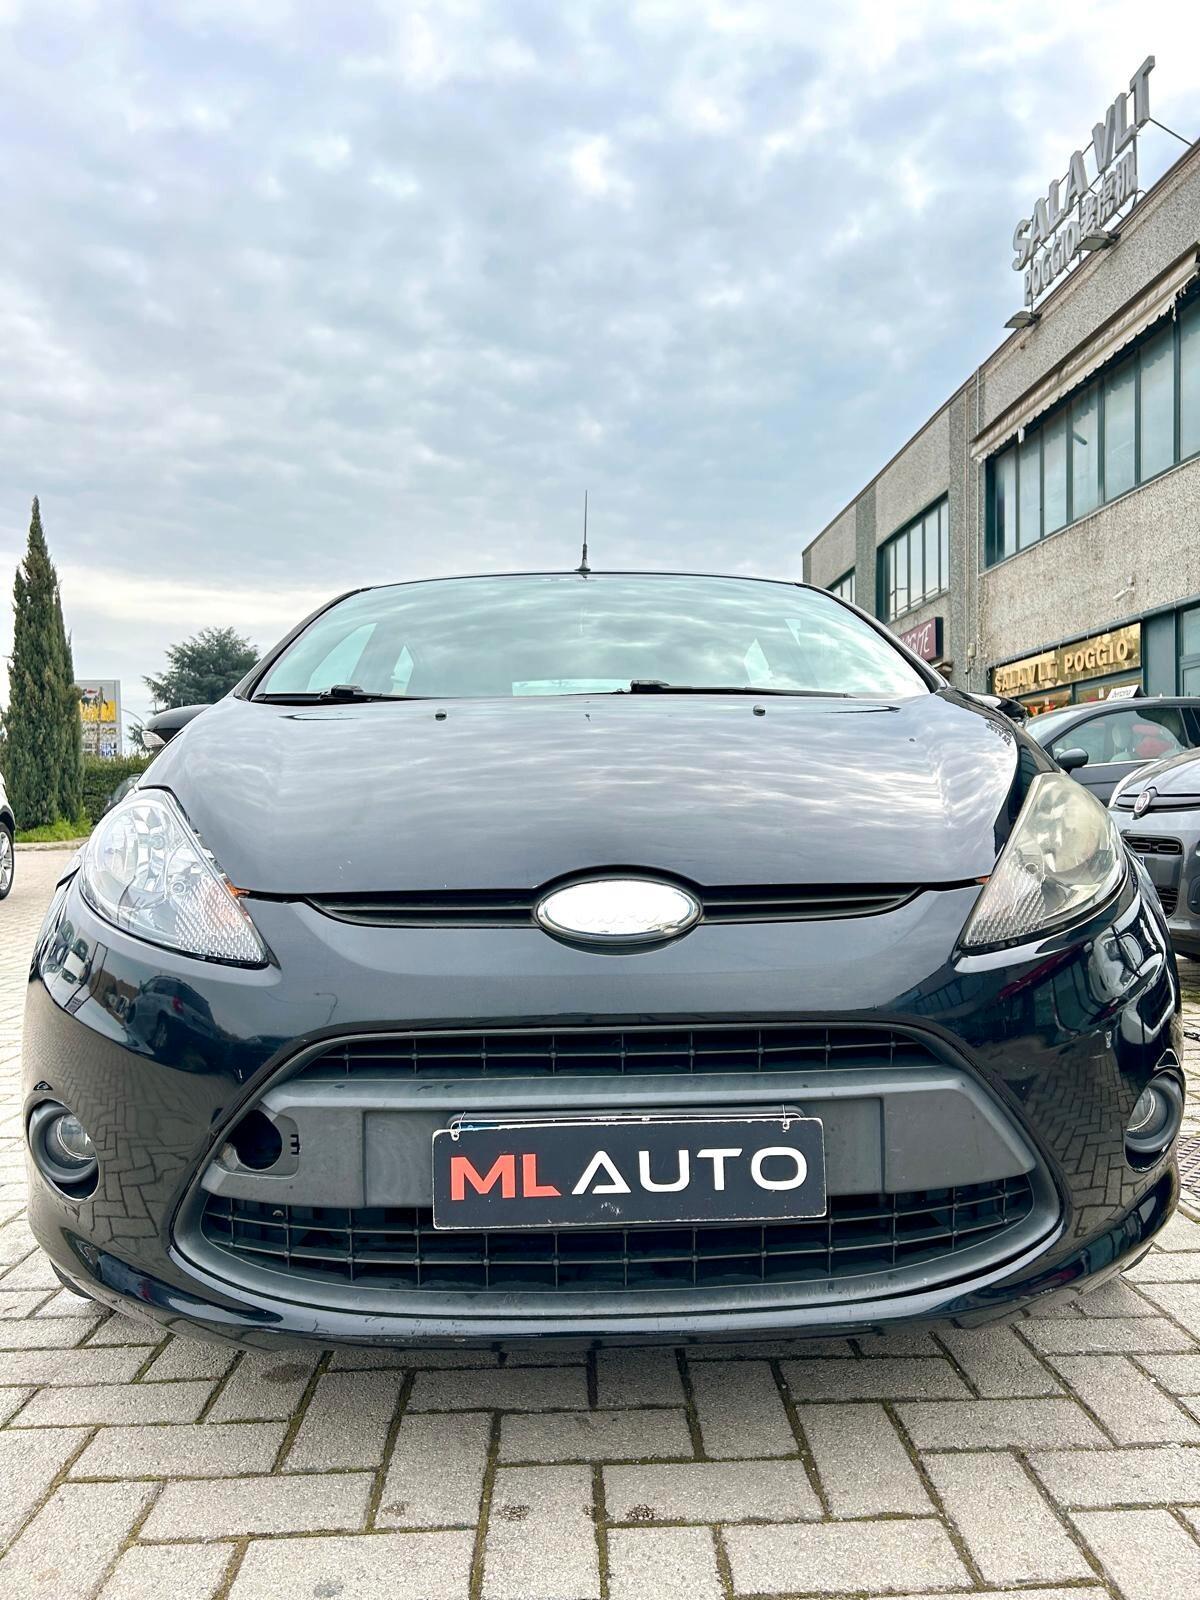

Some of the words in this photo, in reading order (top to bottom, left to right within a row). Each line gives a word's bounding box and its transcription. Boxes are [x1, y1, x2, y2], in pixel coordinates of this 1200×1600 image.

[1012, 150, 1088, 271] SALA
[1091, 55, 1156, 173] VLT
[1024, 221, 1080, 306] POGGIO
[1064, 639, 1128, 675] POGGIO
[450, 1153, 562, 1200] ML
[571, 1146, 808, 1195] AUTO
